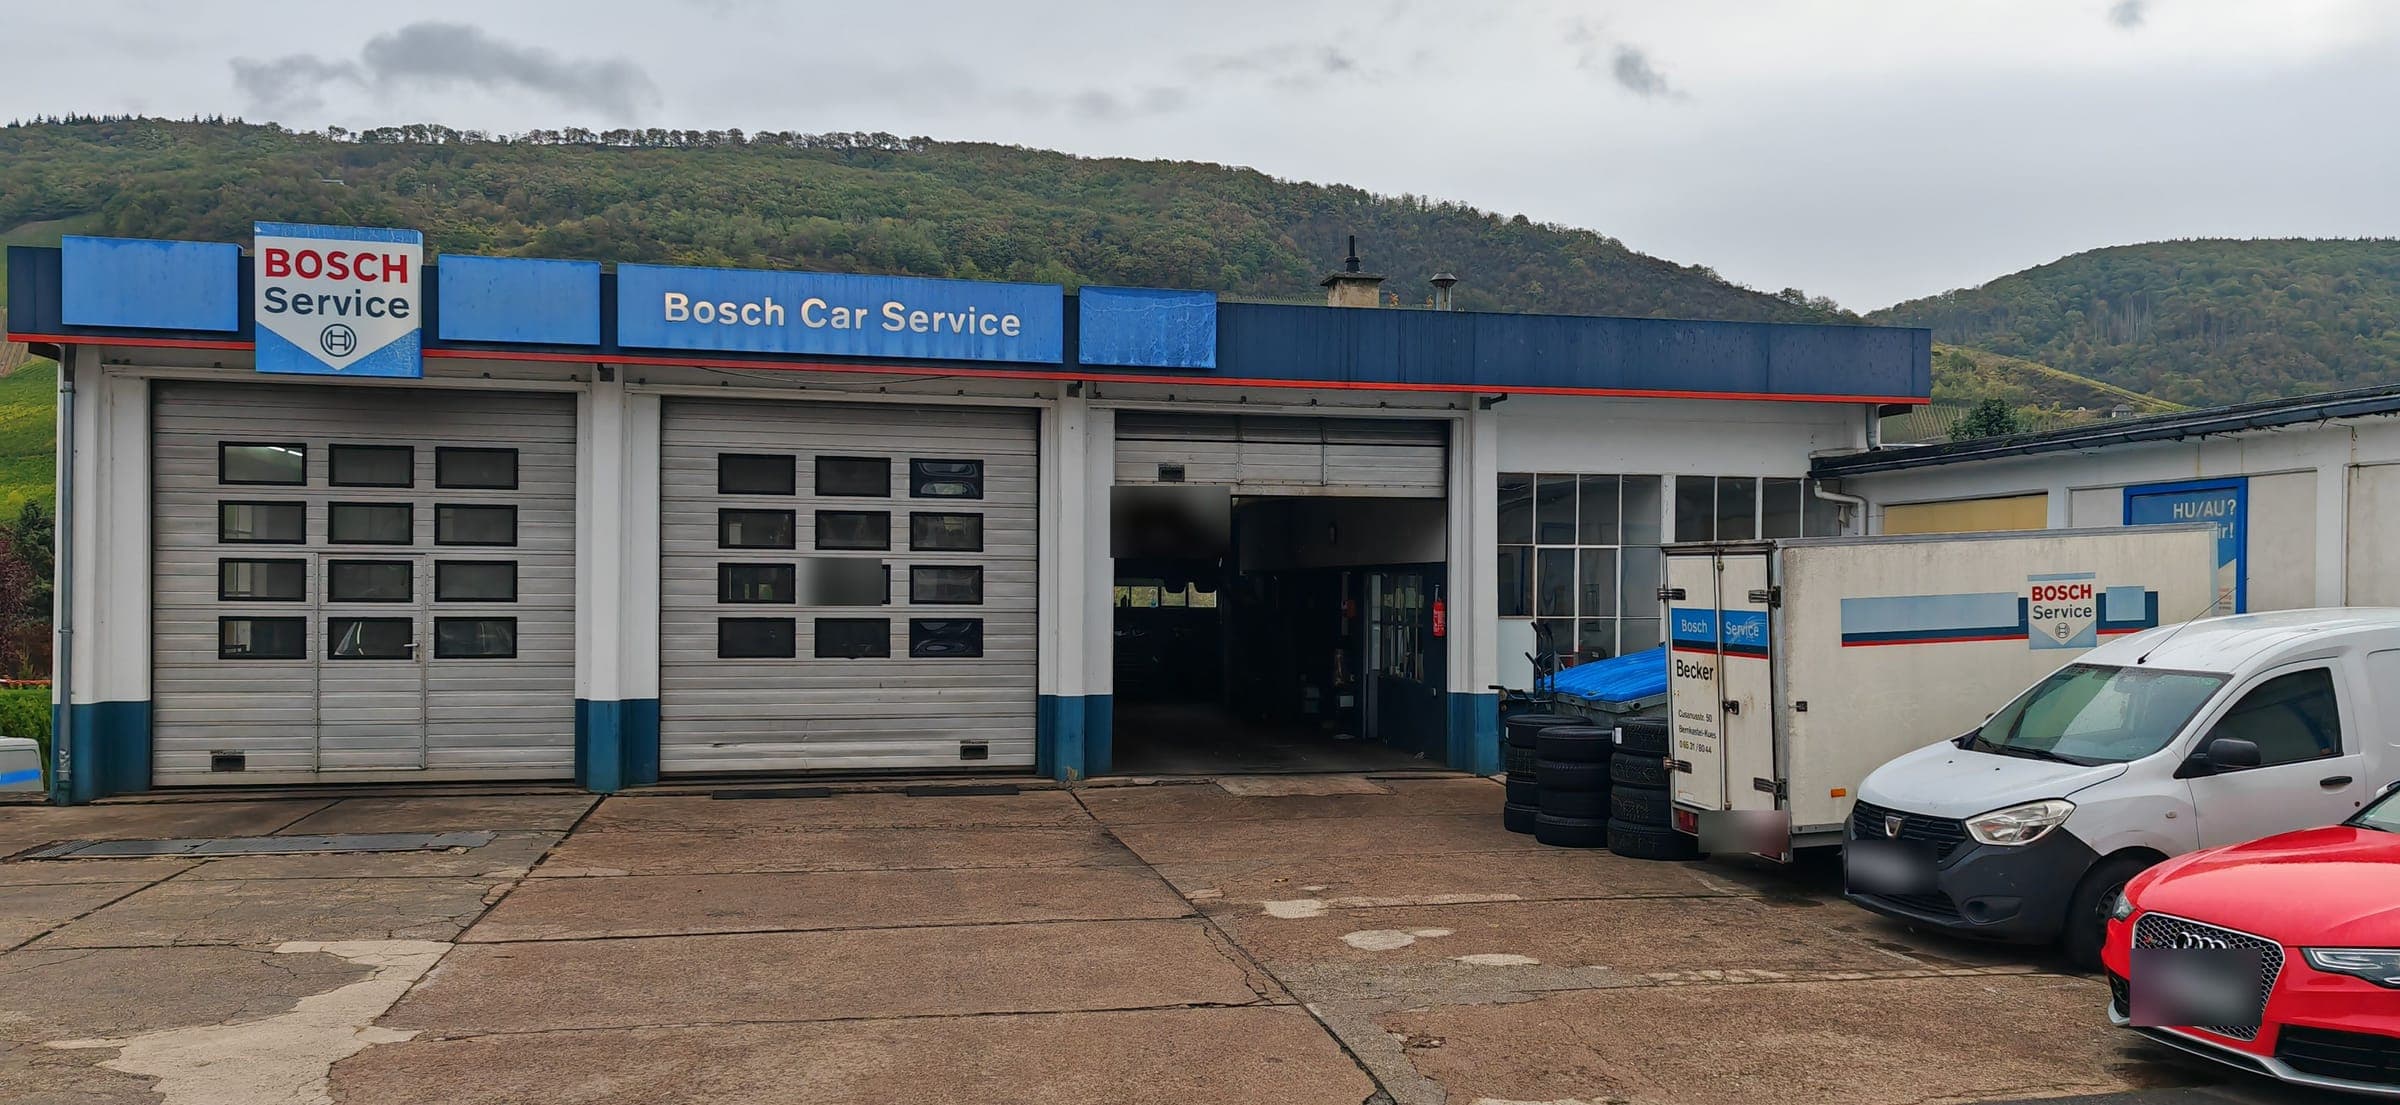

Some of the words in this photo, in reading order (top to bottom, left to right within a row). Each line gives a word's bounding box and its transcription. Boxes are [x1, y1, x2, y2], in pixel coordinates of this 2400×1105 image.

[265, 248, 408, 284] BOSCH
[264, 287, 410, 318] Service
[664, 292, 785, 326] Bosch
[801, 298, 867, 330] Car
[881, 302, 1021, 337] Service
[2173, 499, 2237, 519] HU/AU?
[2218, 522, 2234, 539] ir!
[2031, 584, 2092, 602] BOSCH
[2032, 604, 2092, 620] Service
[1681, 619, 1708, 633] Bosch
[1725, 621, 1759, 637] Service
[1676, 659, 1714, 680] Becker
